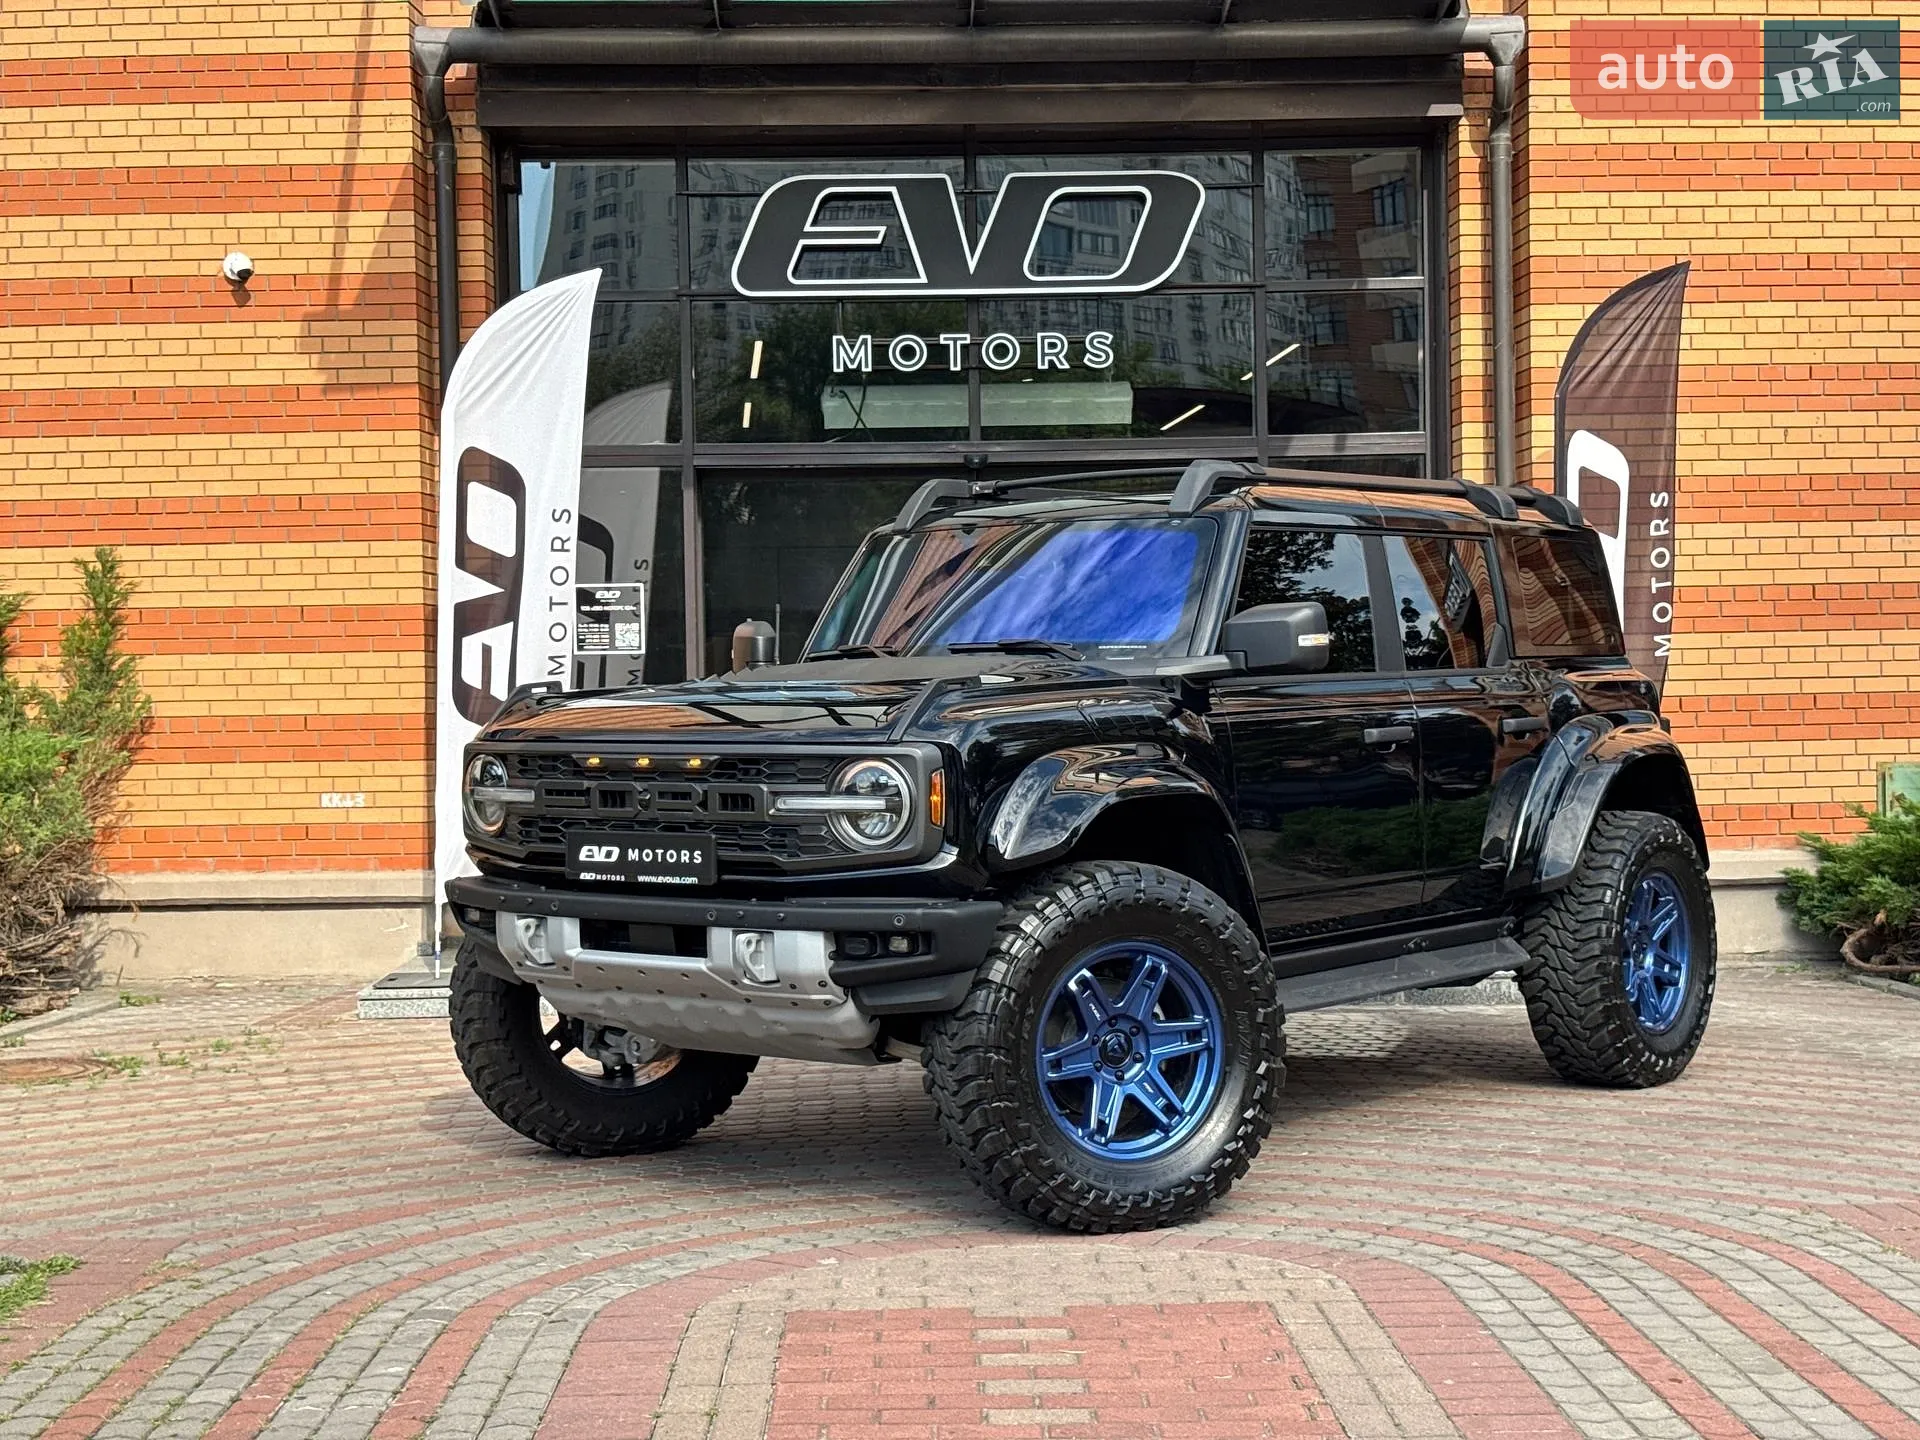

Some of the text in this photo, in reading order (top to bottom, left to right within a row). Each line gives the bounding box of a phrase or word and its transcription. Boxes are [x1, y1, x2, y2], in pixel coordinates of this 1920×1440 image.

[730, 170, 1206, 298] EVO
[831, 331, 1114, 373] MOTORS
[452, 446, 526, 727] EVO
[547, 507, 572, 676] MOTORS
[1650, 491, 1673, 657] MOTORS
[535, 781, 768, 822] FORD
[578, 845, 703, 864] EVO MOTORS
[637, 874, 699, 884] www.evoua.com
